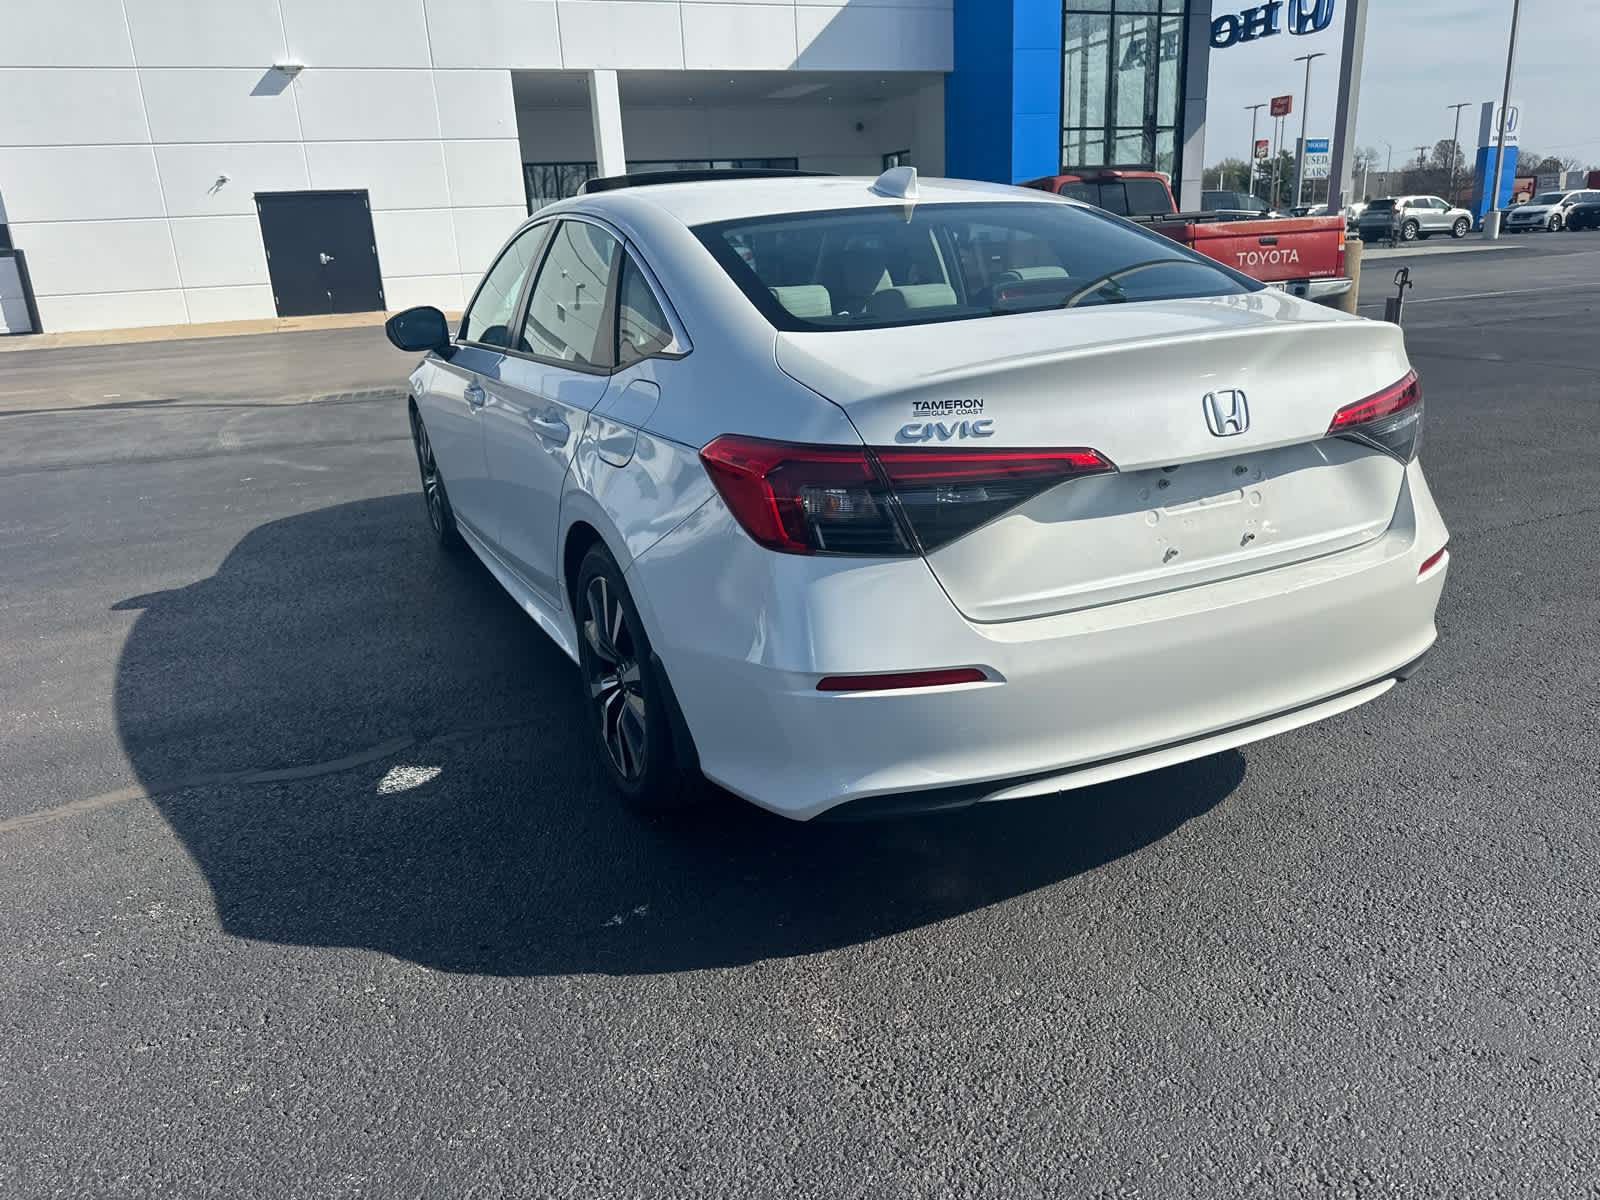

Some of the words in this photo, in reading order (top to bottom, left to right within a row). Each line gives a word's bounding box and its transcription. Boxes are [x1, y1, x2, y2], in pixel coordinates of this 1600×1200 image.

[1305, 155, 1328, 164] USED
[1304, 167, 1327, 176] CARS
[1236, 249, 1298, 266] TOYOTA
[912, 399, 984, 410] TAMERON
[895, 419, 994, 443] CIVIC
